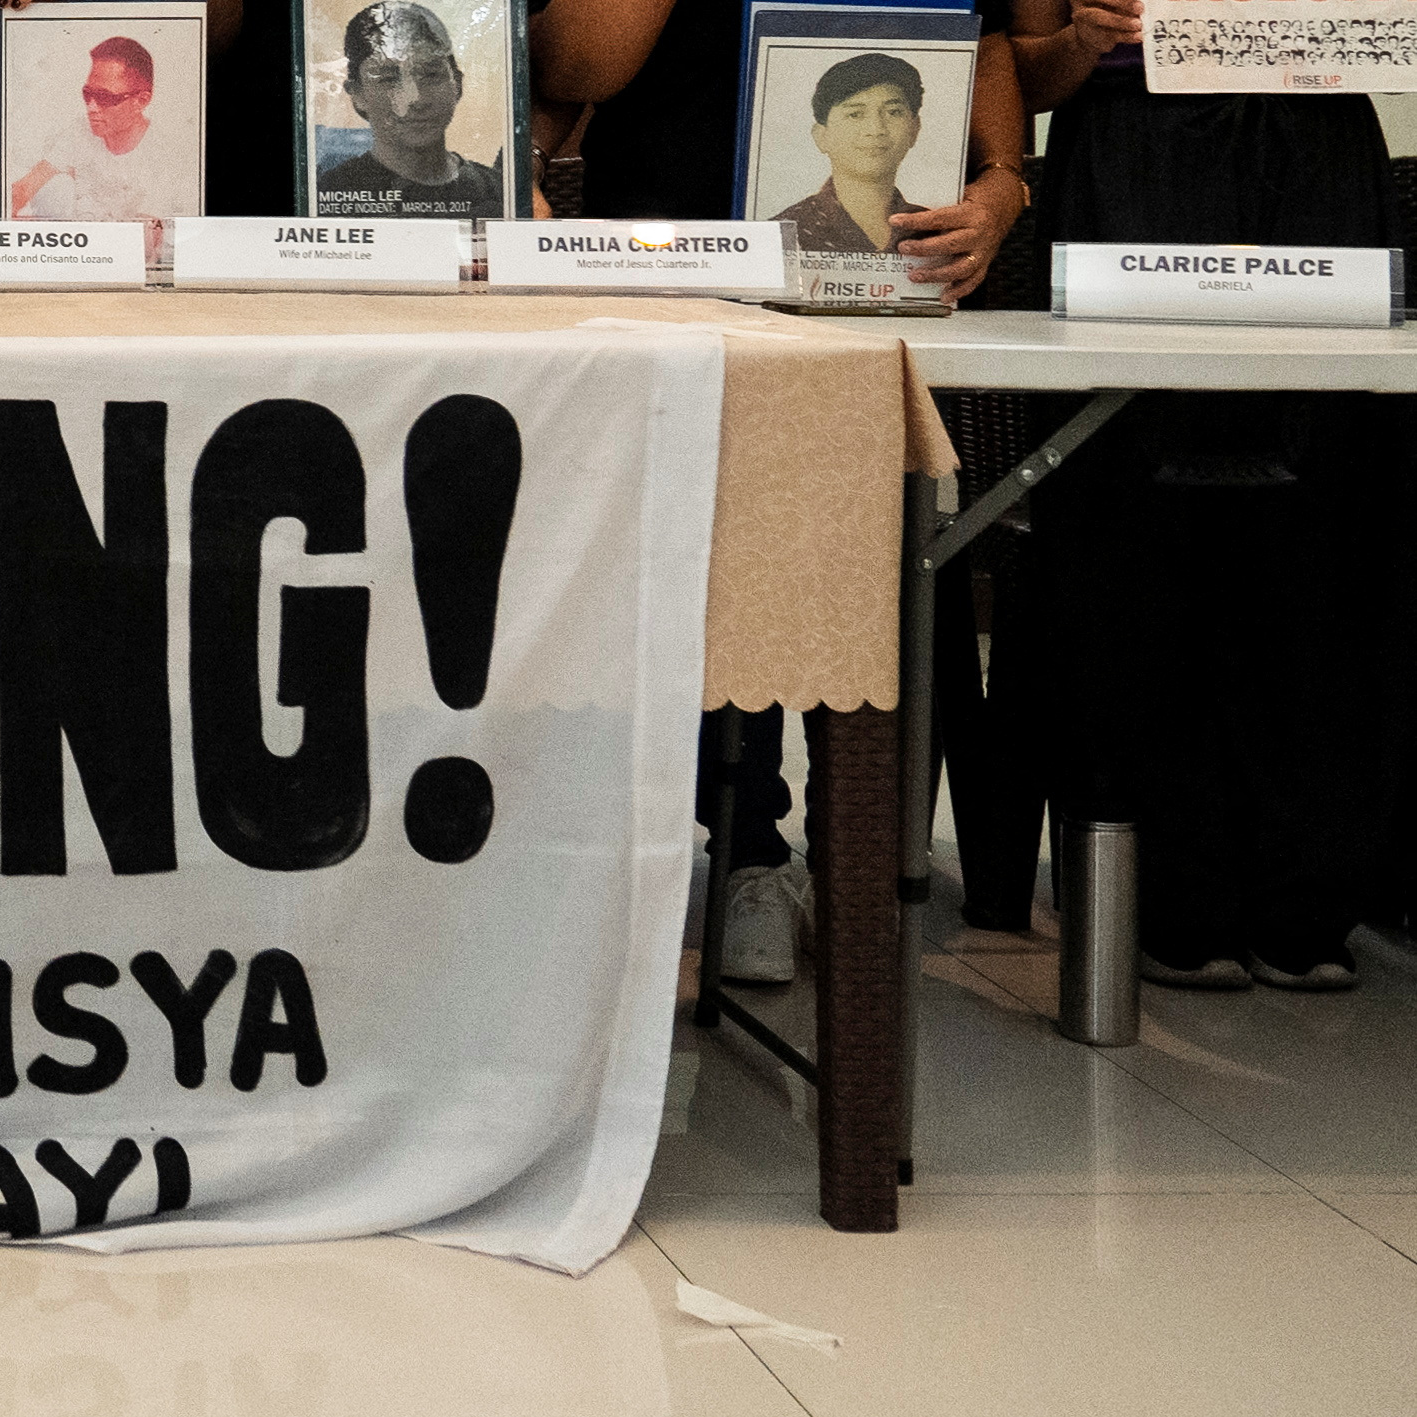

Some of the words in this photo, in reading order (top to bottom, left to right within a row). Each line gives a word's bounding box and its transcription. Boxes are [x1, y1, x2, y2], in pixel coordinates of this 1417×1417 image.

[1293, 76, 1321, 84] RISE
[1326, 76, 1342, 84] UP
[319, 191, 374, 201] MICHAEL
[379, 191, 402, 201] LEE
[18, 233, 88, 247] PASCO
[275, 228, 328, 243] JANE
[336, 229, 374, 243] LEE
[538, 237, 621, 252] DAHLIA
[20, 254, 38, 262] and
[40, 254, 79, 263] Crisanto
[81, 255, 113, 263] Lozano
[279, 249, 300, 259] Wife
[302, 249, 313, 259] of
[315, 250, 352, 260] Michael
[355, 251, 371, 259] Lee
[577, 260, 611, 268] Mother
[615, 260, 624, 268] of
[626, 260, 653, 268] Jesus
[656, 260, 698, 268] Cuartero
[701, 260, 711, 268] Jr.
[1121, 255, 1236, 273] CLARICE
[1246, 258, 1333, 276] PALCE
[824, 282, 865, 296] RISE
[870, 285, 895, 297] UP
[1198, 281, 1253, 291] GABRIELA
